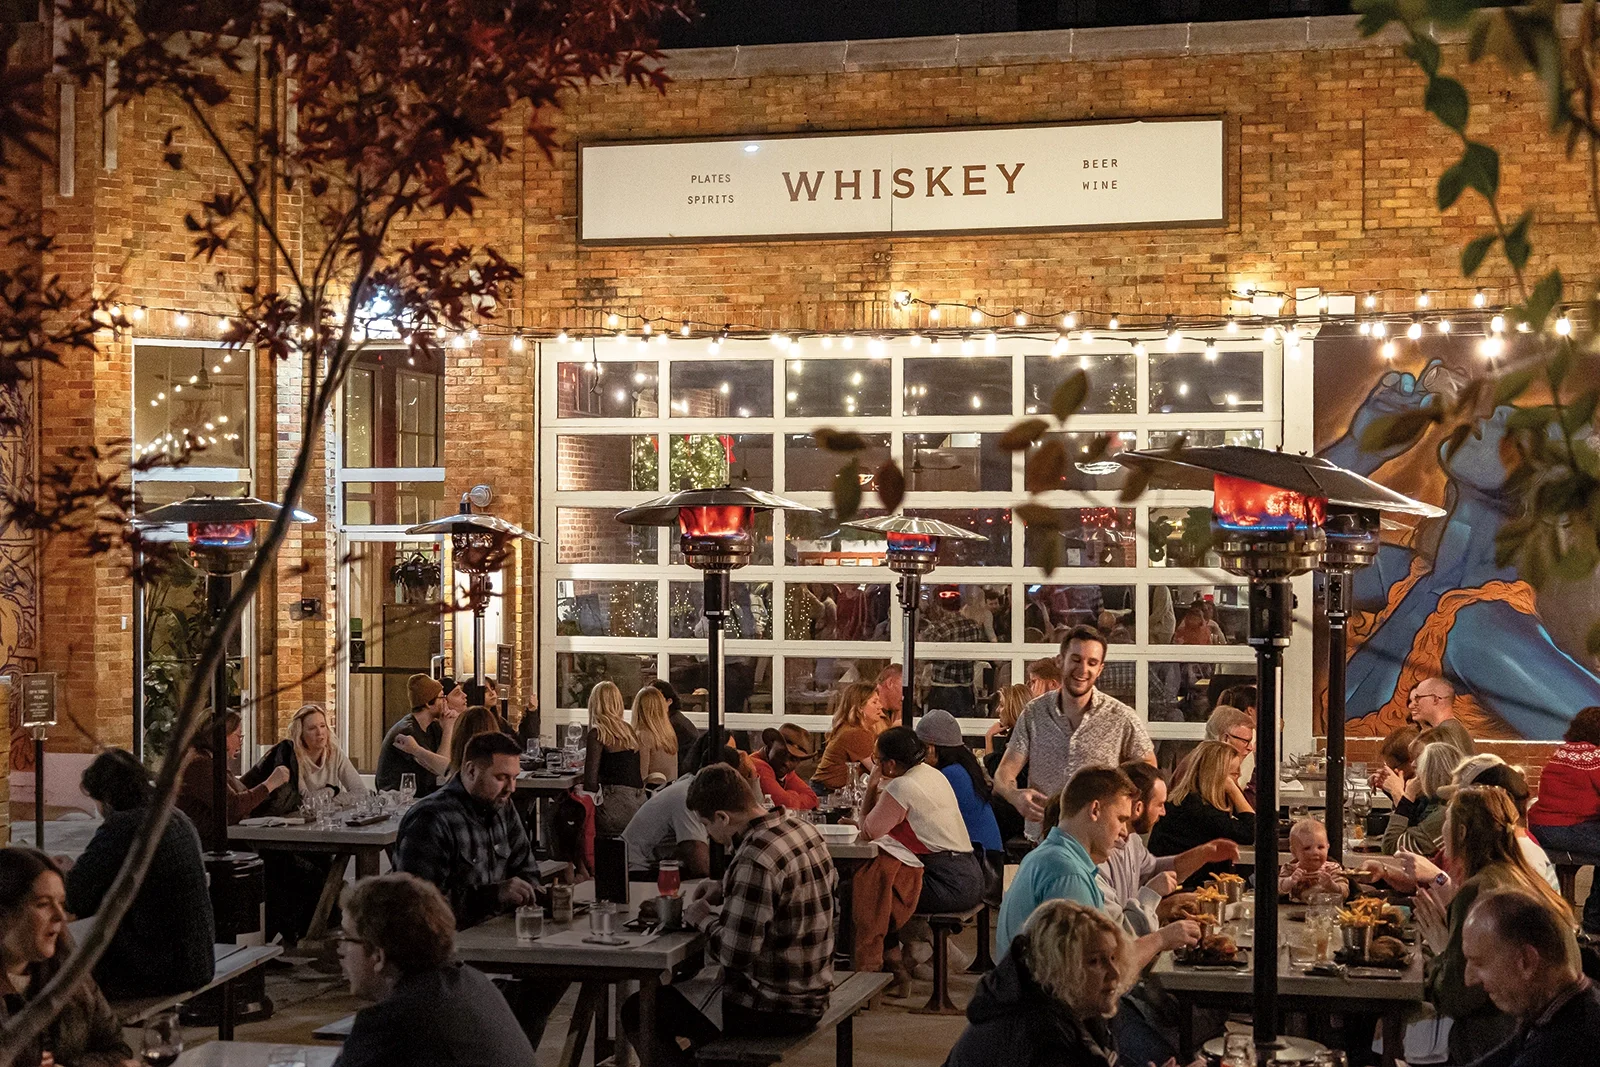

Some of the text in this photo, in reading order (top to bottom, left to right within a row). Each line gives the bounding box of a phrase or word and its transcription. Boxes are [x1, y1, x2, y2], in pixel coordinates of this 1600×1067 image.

[1083, 159, 1119, 169] BEER
[691, 174, 732, 184] PLATES
[782, 163, 1025, 202] WHISKEY
[1082, 180, 1119, 190] WINE
[687, 194, 735, 205] SPIRITS
